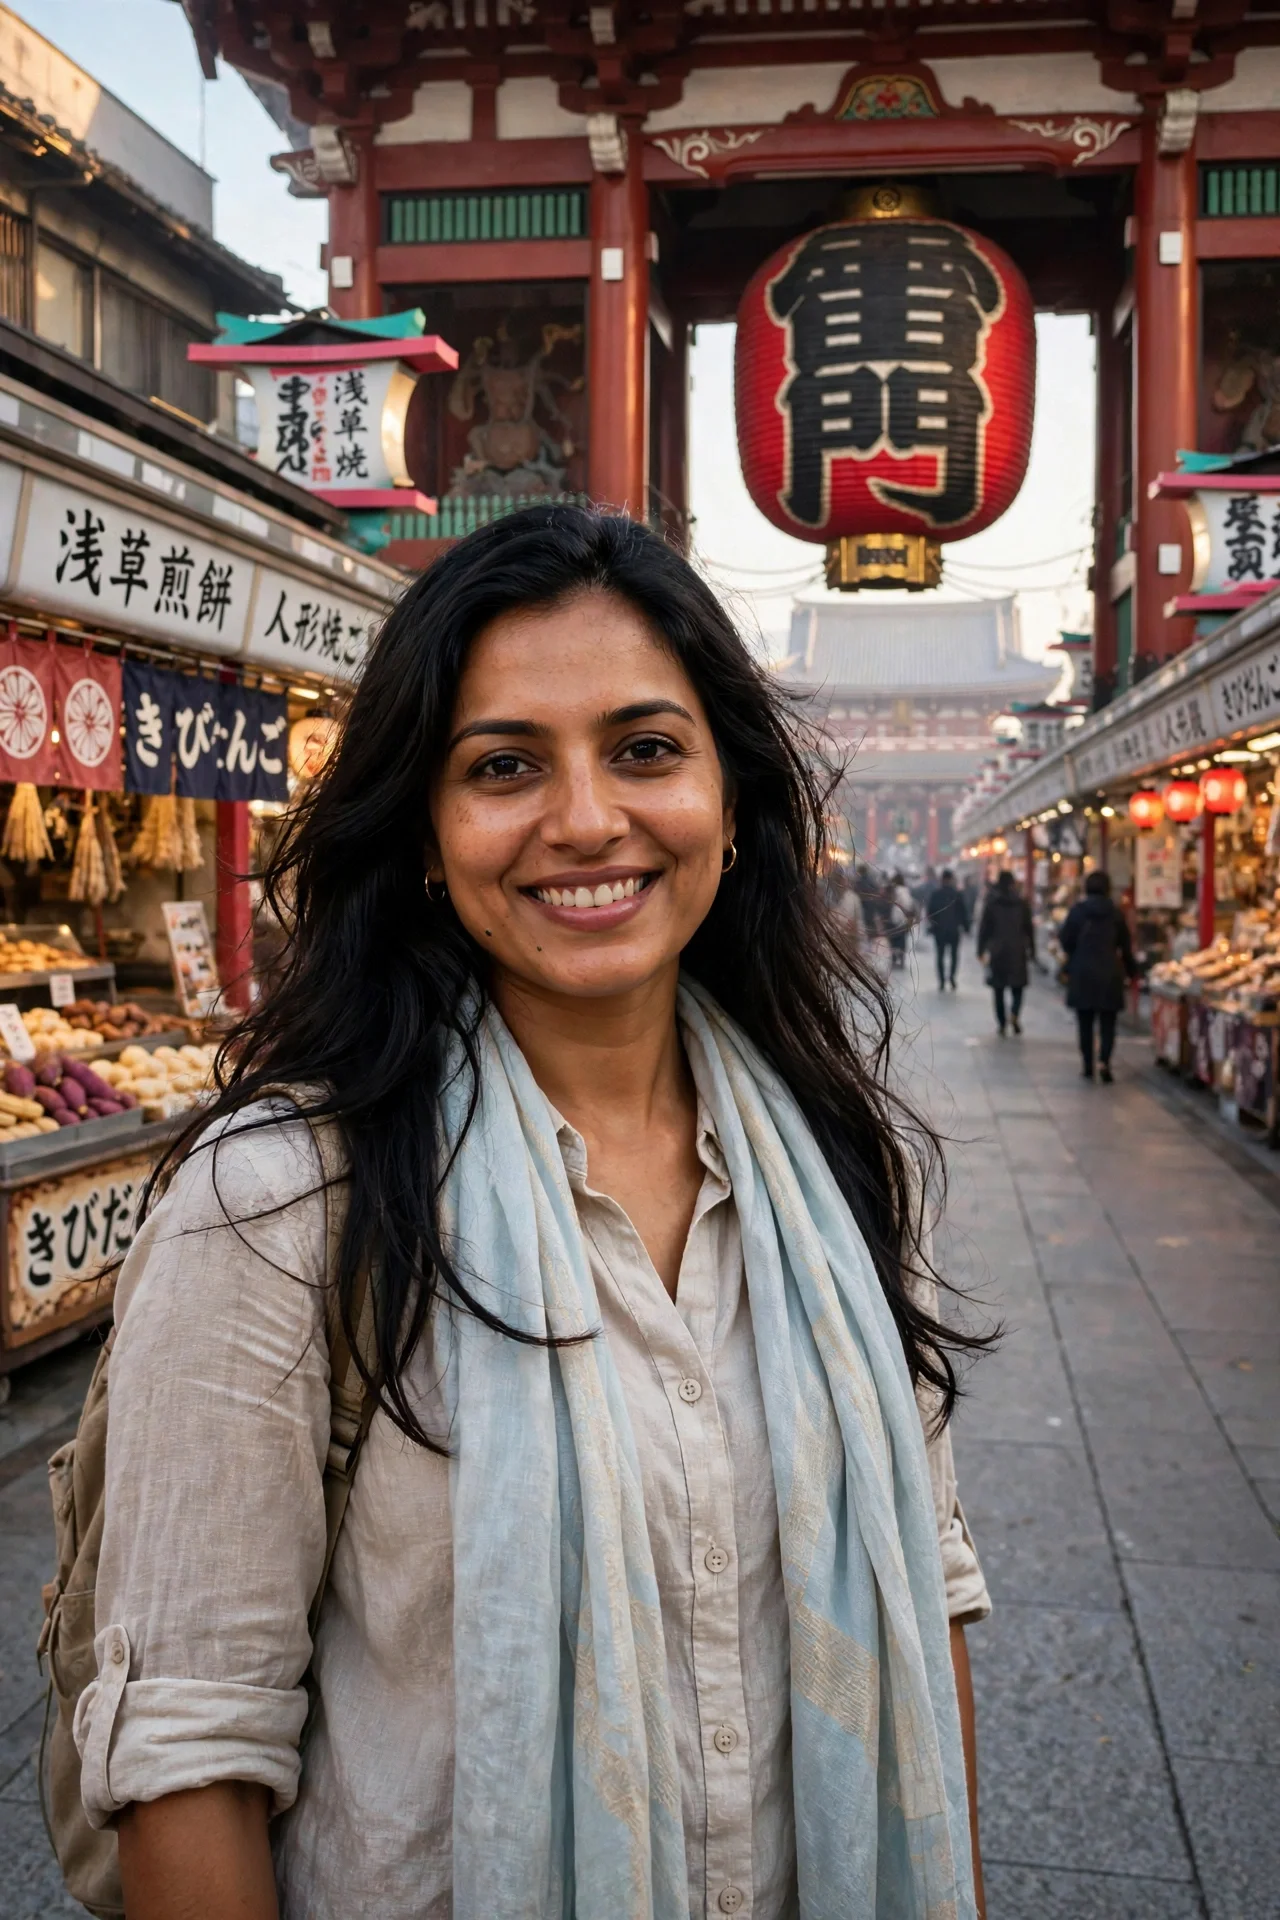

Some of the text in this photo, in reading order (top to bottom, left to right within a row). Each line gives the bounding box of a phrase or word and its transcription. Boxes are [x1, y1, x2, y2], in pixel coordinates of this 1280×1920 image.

[334, 371, 369, 477] 浅草焼
[56, 509, 233, 632] 浅草煎餅
[27, 1183, 150, 1286] きびだ
